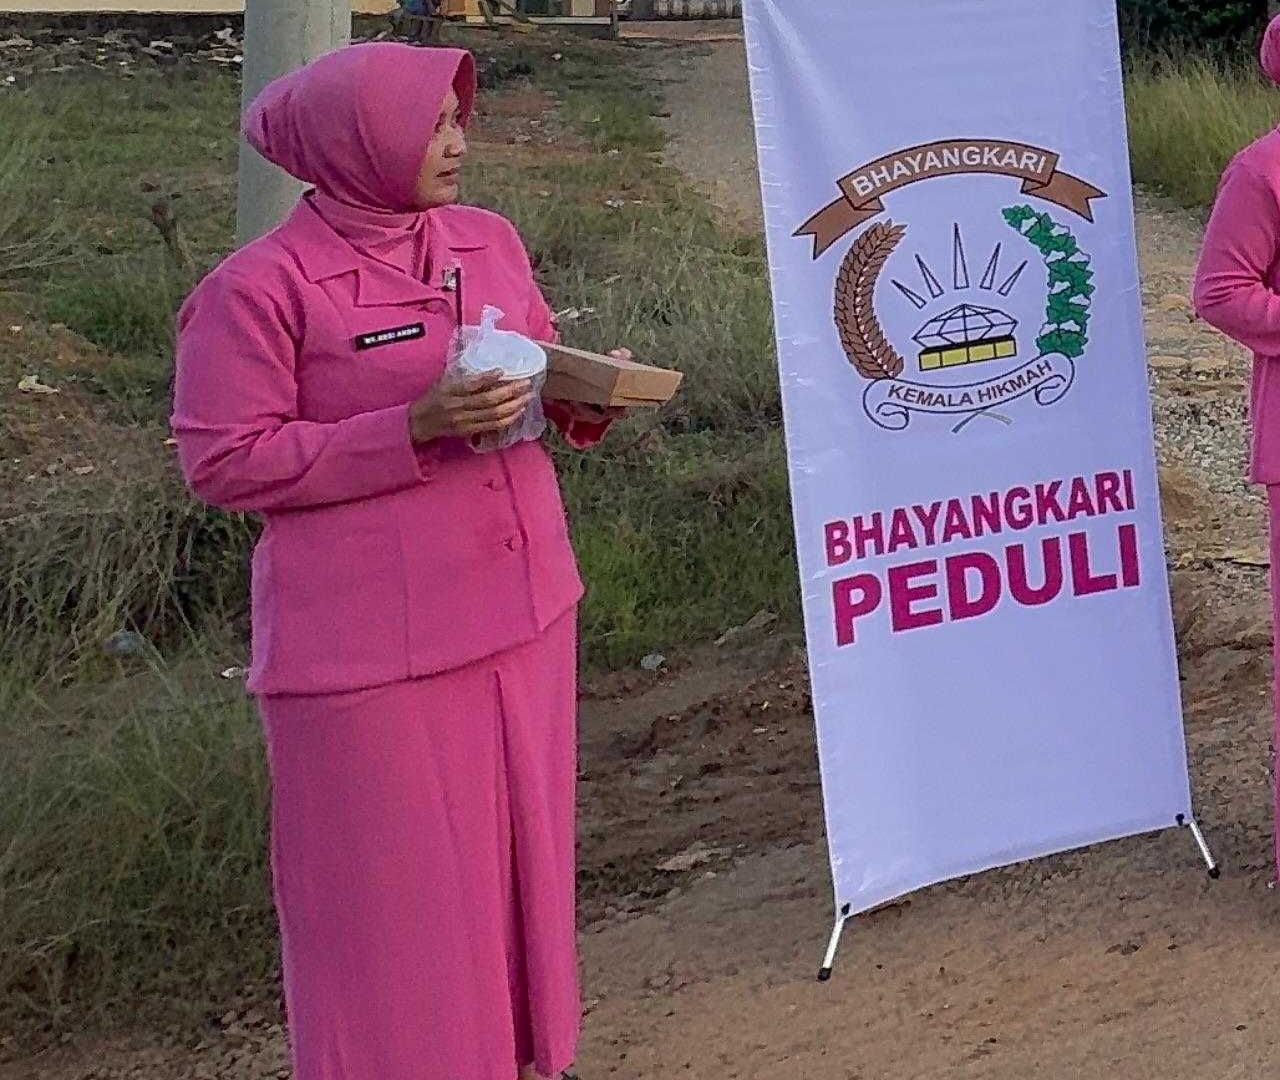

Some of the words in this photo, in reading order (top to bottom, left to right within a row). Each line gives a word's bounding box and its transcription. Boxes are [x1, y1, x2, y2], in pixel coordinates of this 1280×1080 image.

[851, 146, 1047, 198] BHAYANGKARI
[887, 384, 975, 408] KEMALA
[977, 359, 1053, 402] HIKMAH
[824, 470, 1136, 566] BHAYANGKARI
[832, 523, 1141, 647] PEDULI
